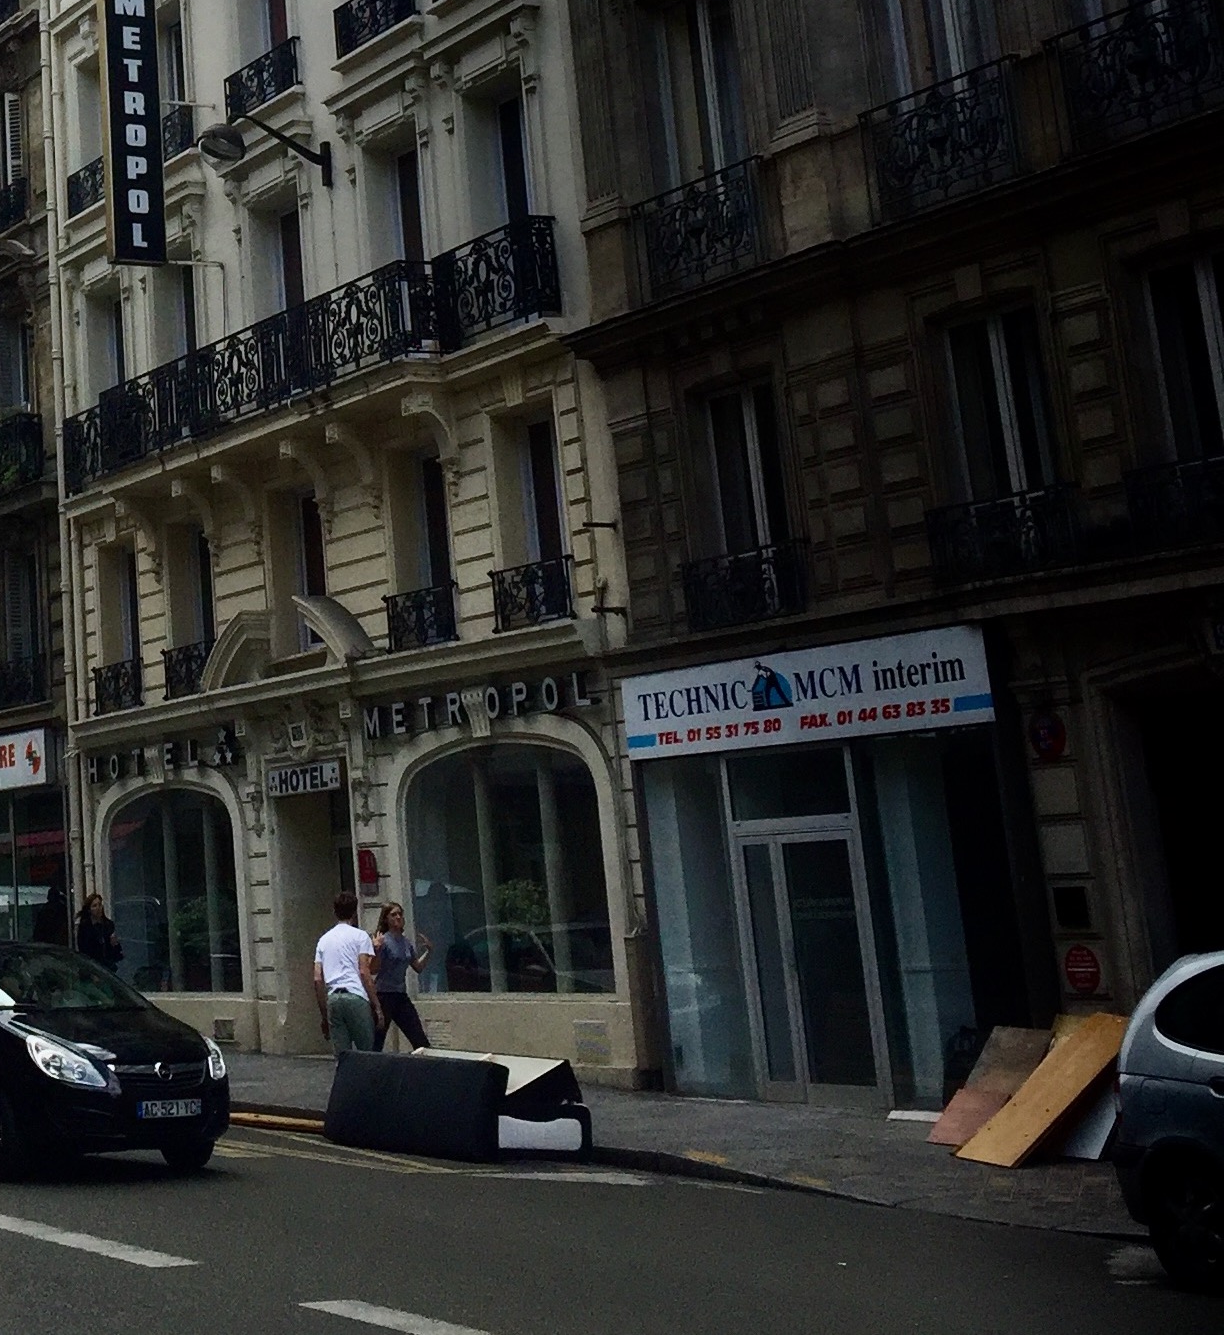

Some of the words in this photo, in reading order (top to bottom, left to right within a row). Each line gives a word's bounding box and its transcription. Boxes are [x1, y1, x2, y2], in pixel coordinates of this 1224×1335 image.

[793, 663, 864, 702] MCM
[872, 651, 967, 692] interim
[364, 671, 592, 738] METROPOL
[687, 728, 702, 743] 01
[706, 726, 721, 741] 55
[725, 723, 739, 738] 31
[743, 719, 760, 736] 75
[763, 717, 782, 733] 80
[800, 713, 833, 730] FAX.
[837, 710, 853, 726] 01
[858, 707, 877, 722] 44
[882, 704, 902, 720] 63
[906, 701, 926, 717] 83
[930, 698, 951, 715] 35
[88, 739, 199, 784] HOTEL
[278, 765, 329, 794] HOTEL
